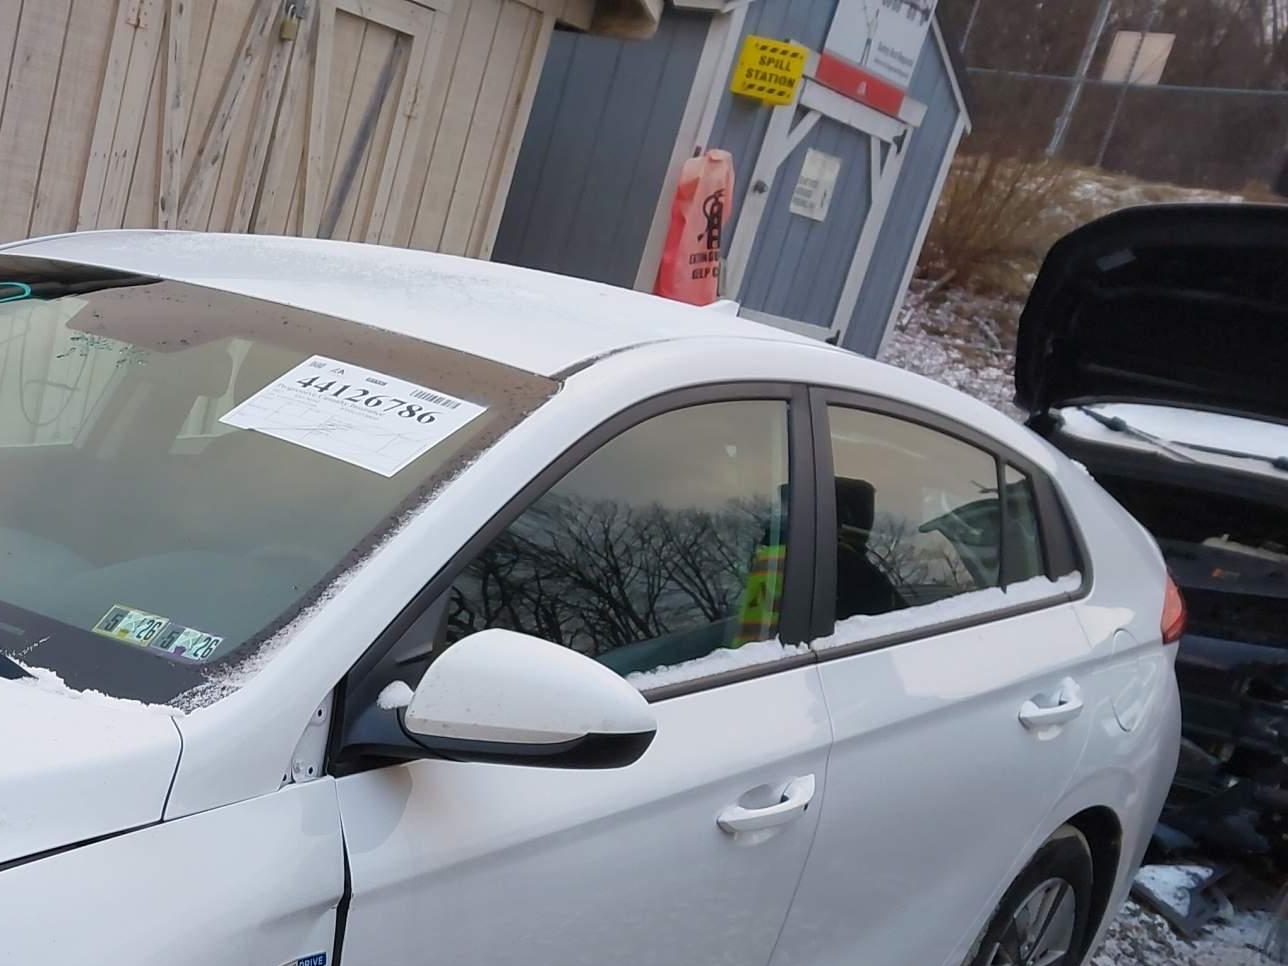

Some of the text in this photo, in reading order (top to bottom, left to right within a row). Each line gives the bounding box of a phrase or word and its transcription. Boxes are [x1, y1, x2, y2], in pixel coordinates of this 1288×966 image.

[758, 55, 792, 72] SPILL
[745, 67, 796, 88] STATION
[296, 376, 444, 424] 44126786
[104, 614, 124, 632] 5
[160, 631, 180, 649] 5
